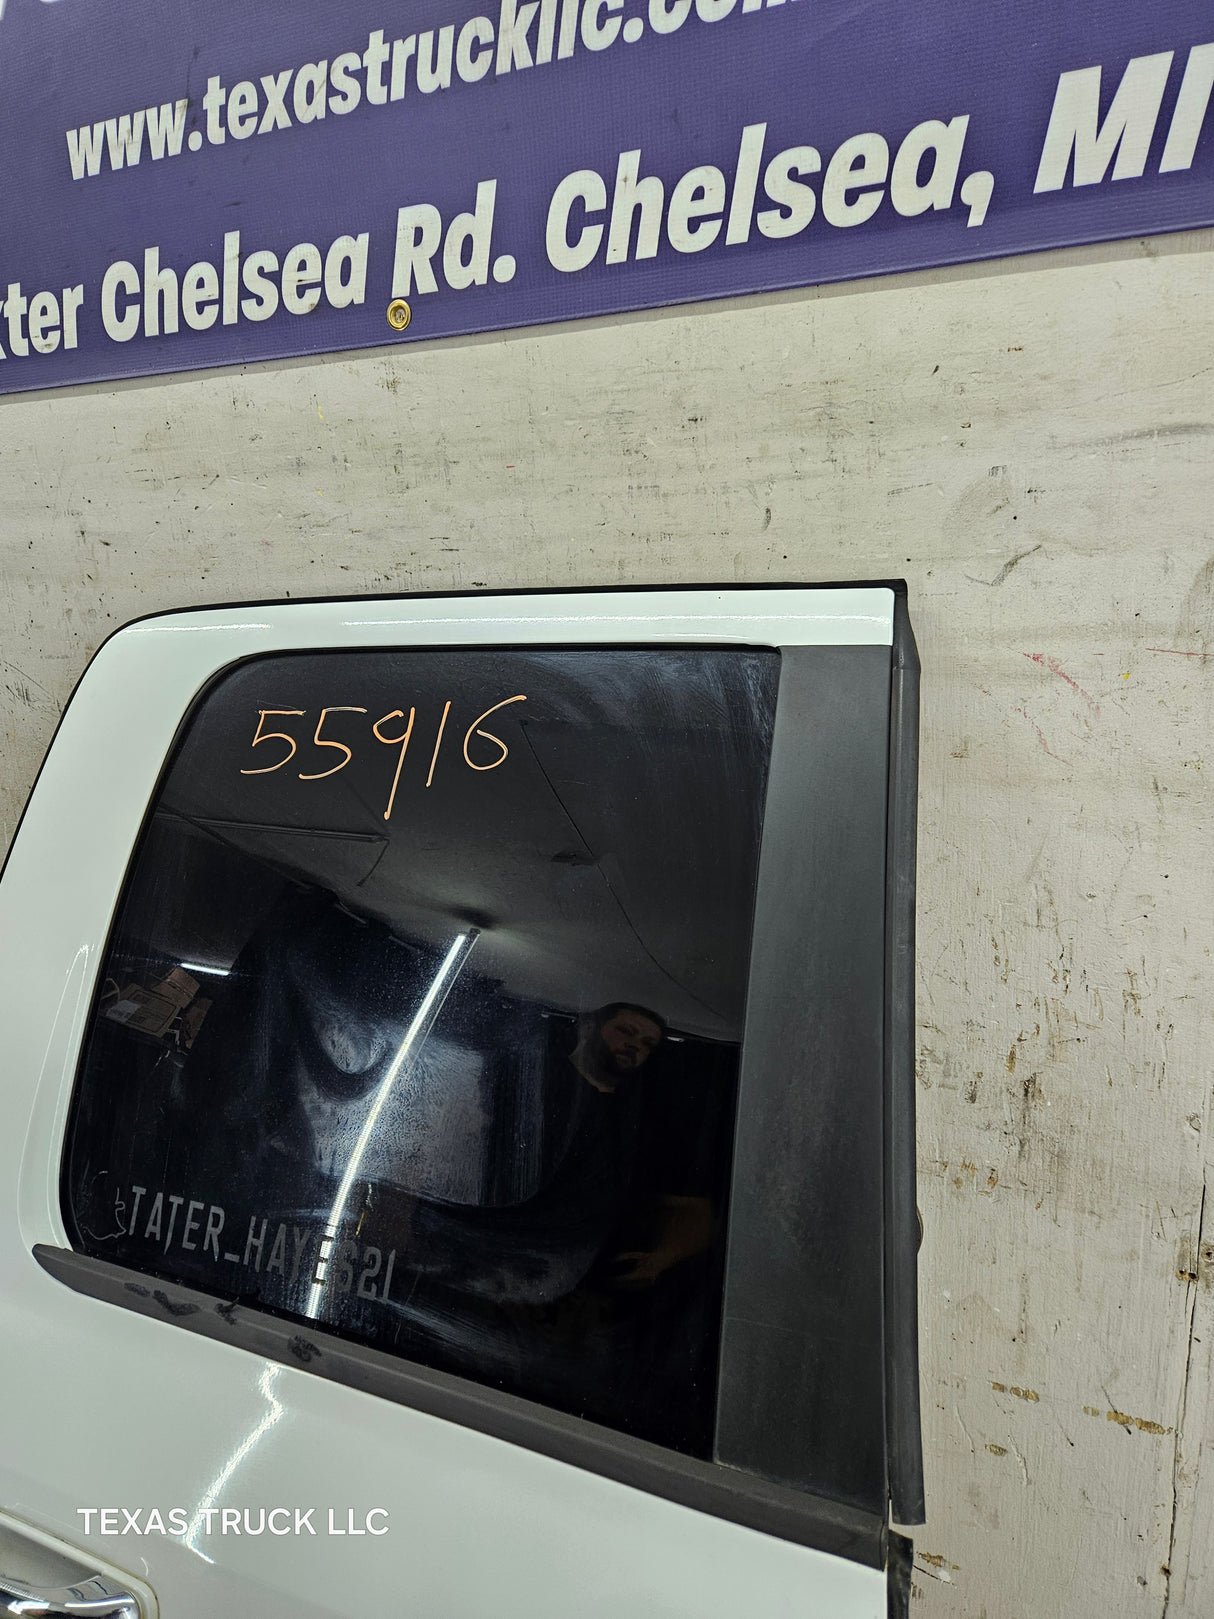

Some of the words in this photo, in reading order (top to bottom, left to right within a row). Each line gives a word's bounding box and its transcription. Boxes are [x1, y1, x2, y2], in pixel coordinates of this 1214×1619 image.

[66, 0, 796, 180] www.texastruckllc.c
[0, 282, 84, 360] ter
[101, 230, 369, 342] Chelsea
[391, 178, 517, 299] Rd.
[546, 115, 995, 273] Chelsea,
[1033, 42, 1214, 195] MI
[240, 694, 527, 821] 55916
